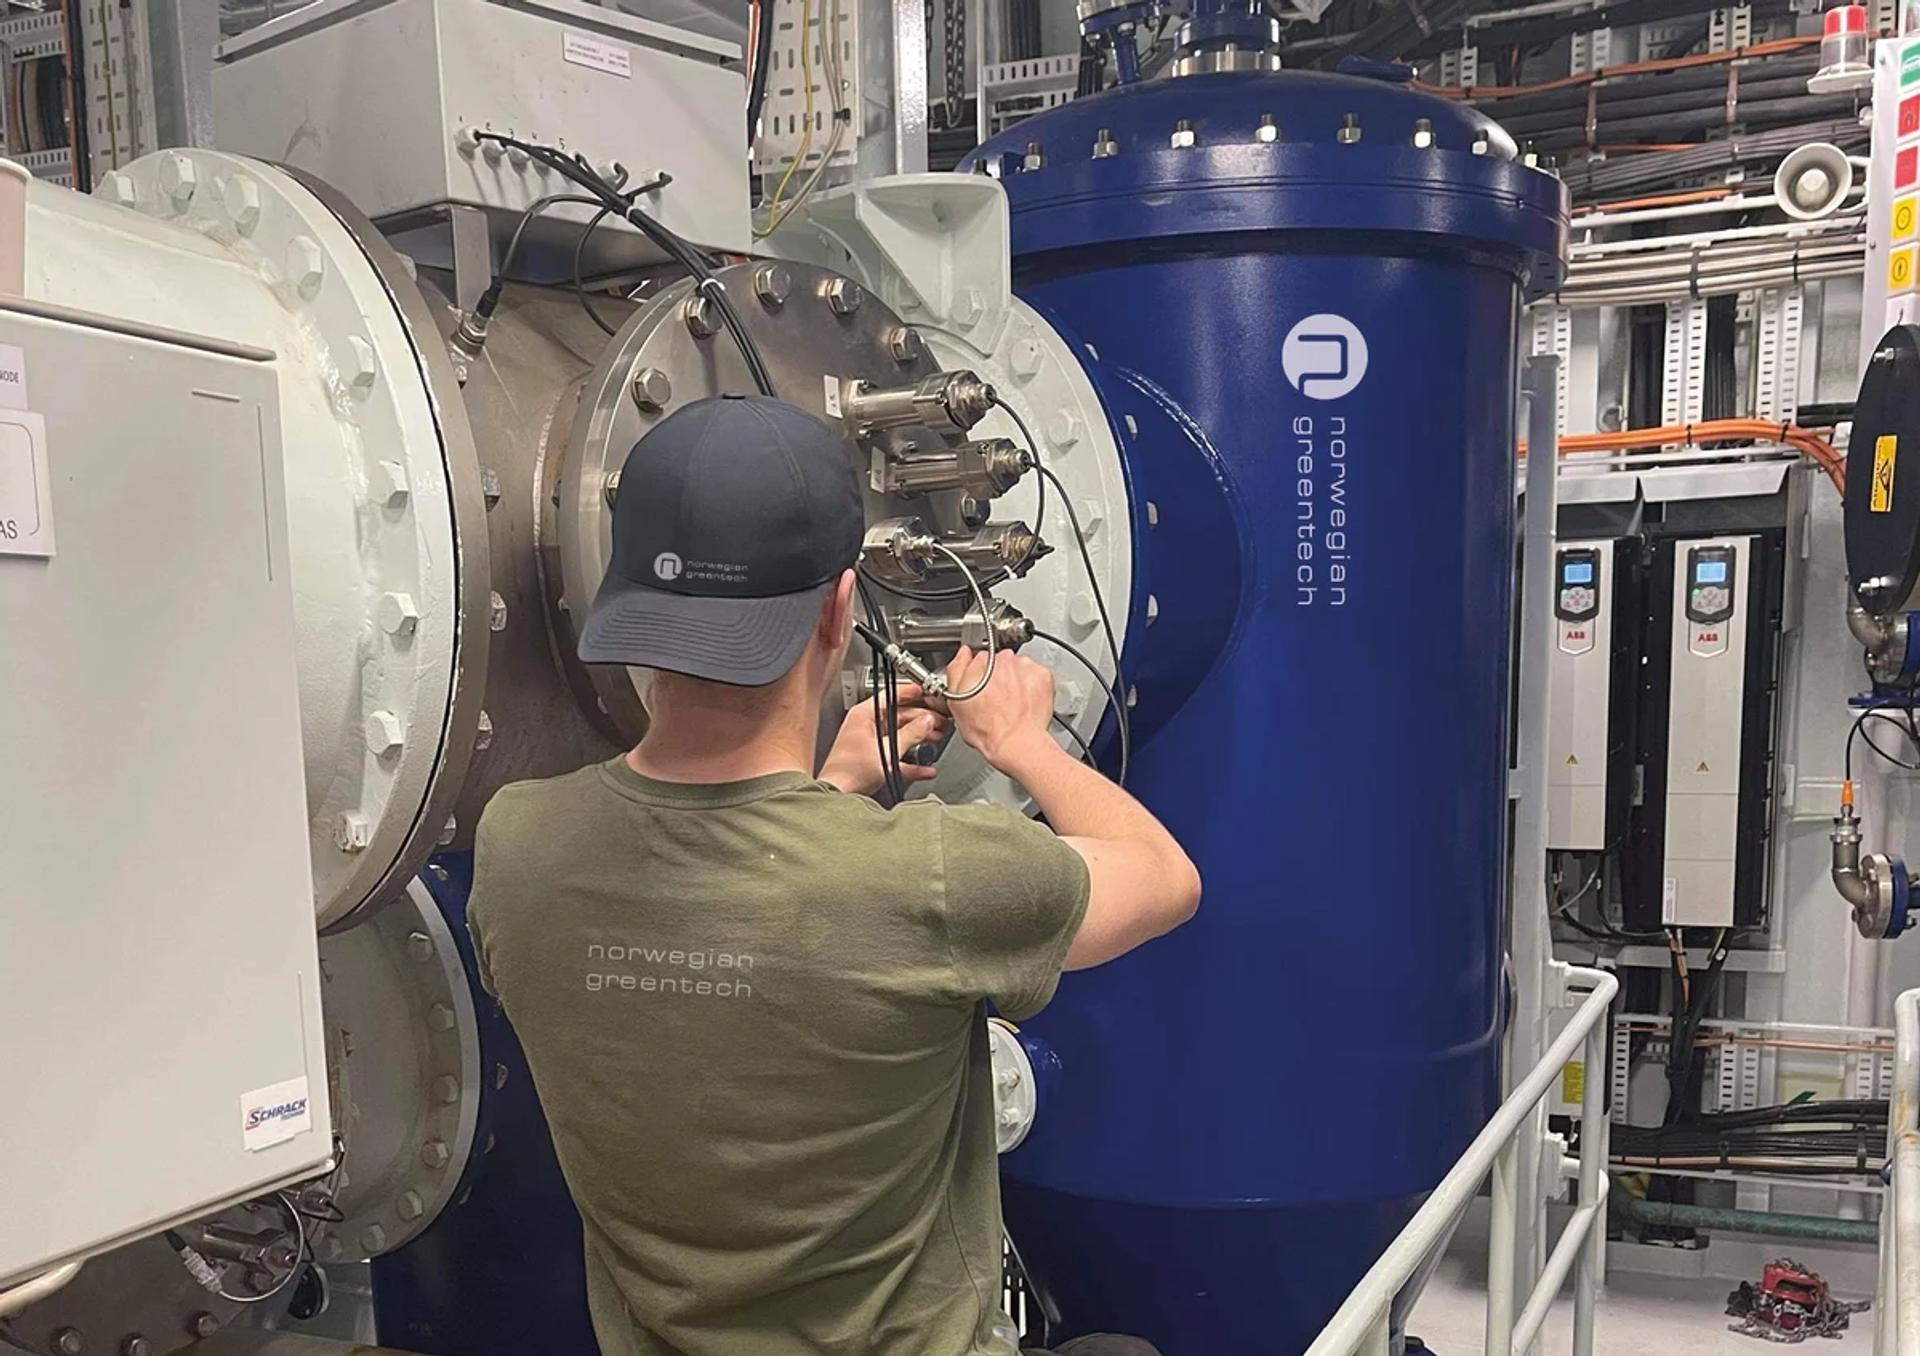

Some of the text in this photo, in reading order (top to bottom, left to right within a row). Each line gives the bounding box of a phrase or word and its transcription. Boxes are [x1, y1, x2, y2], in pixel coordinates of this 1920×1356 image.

[1293, 416, 1318, 605] greentech
[1326, 416, 1351, 605] norwegian
[1566, 631, 1585, 640] ABB
[1697, 633, 1718, 642] ABB
[587, 944, 754, 970] norwegian
[585, 973, 752, 998] greentech
[249, 1098, 307, 1125] SCHRACK
